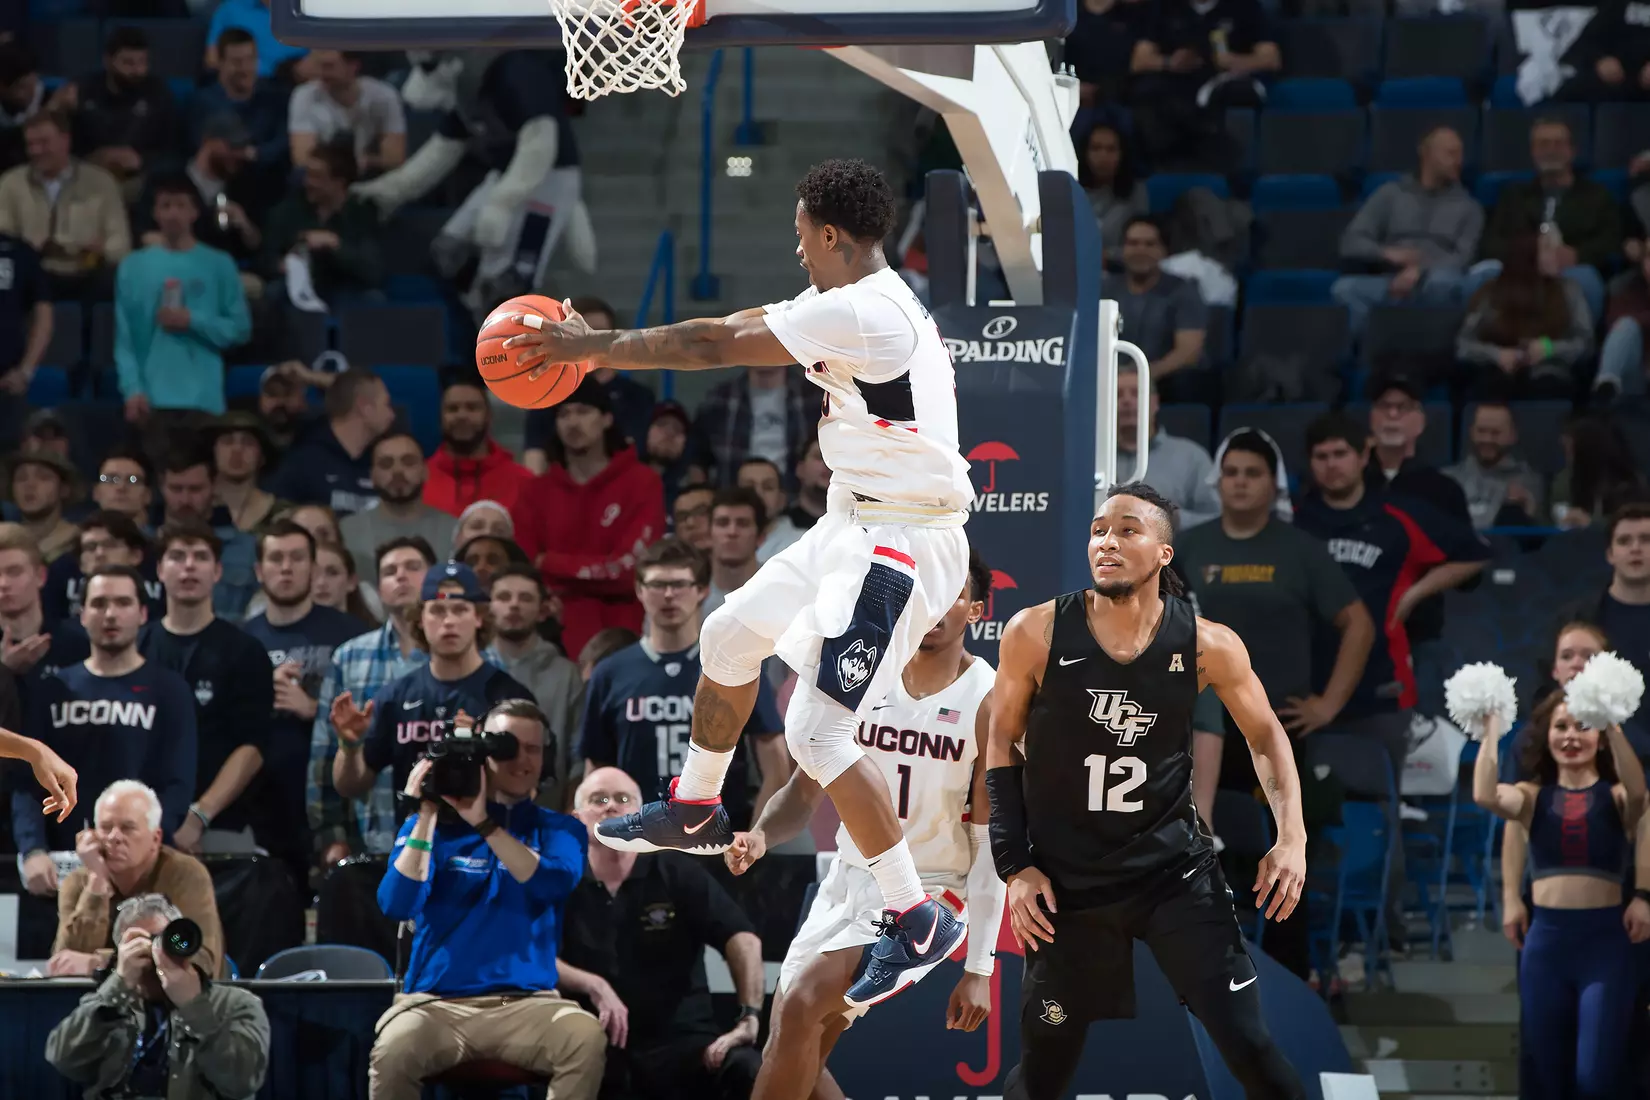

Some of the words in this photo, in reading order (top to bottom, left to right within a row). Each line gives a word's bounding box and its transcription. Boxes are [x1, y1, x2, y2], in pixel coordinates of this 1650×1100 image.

[480, 352, 508, 367] UCONN
[944, 337, 1067, 366] PALDING
[967, 491, 1049, 514] VELERS
[50, 699, 156, 731] UCONN
[1086, 688, 1160, 747] UCF
[859, 721, 965, 762] UCONN
[897, 763, 912, 820] 1
[1084, 753, 1148, 813] 12
